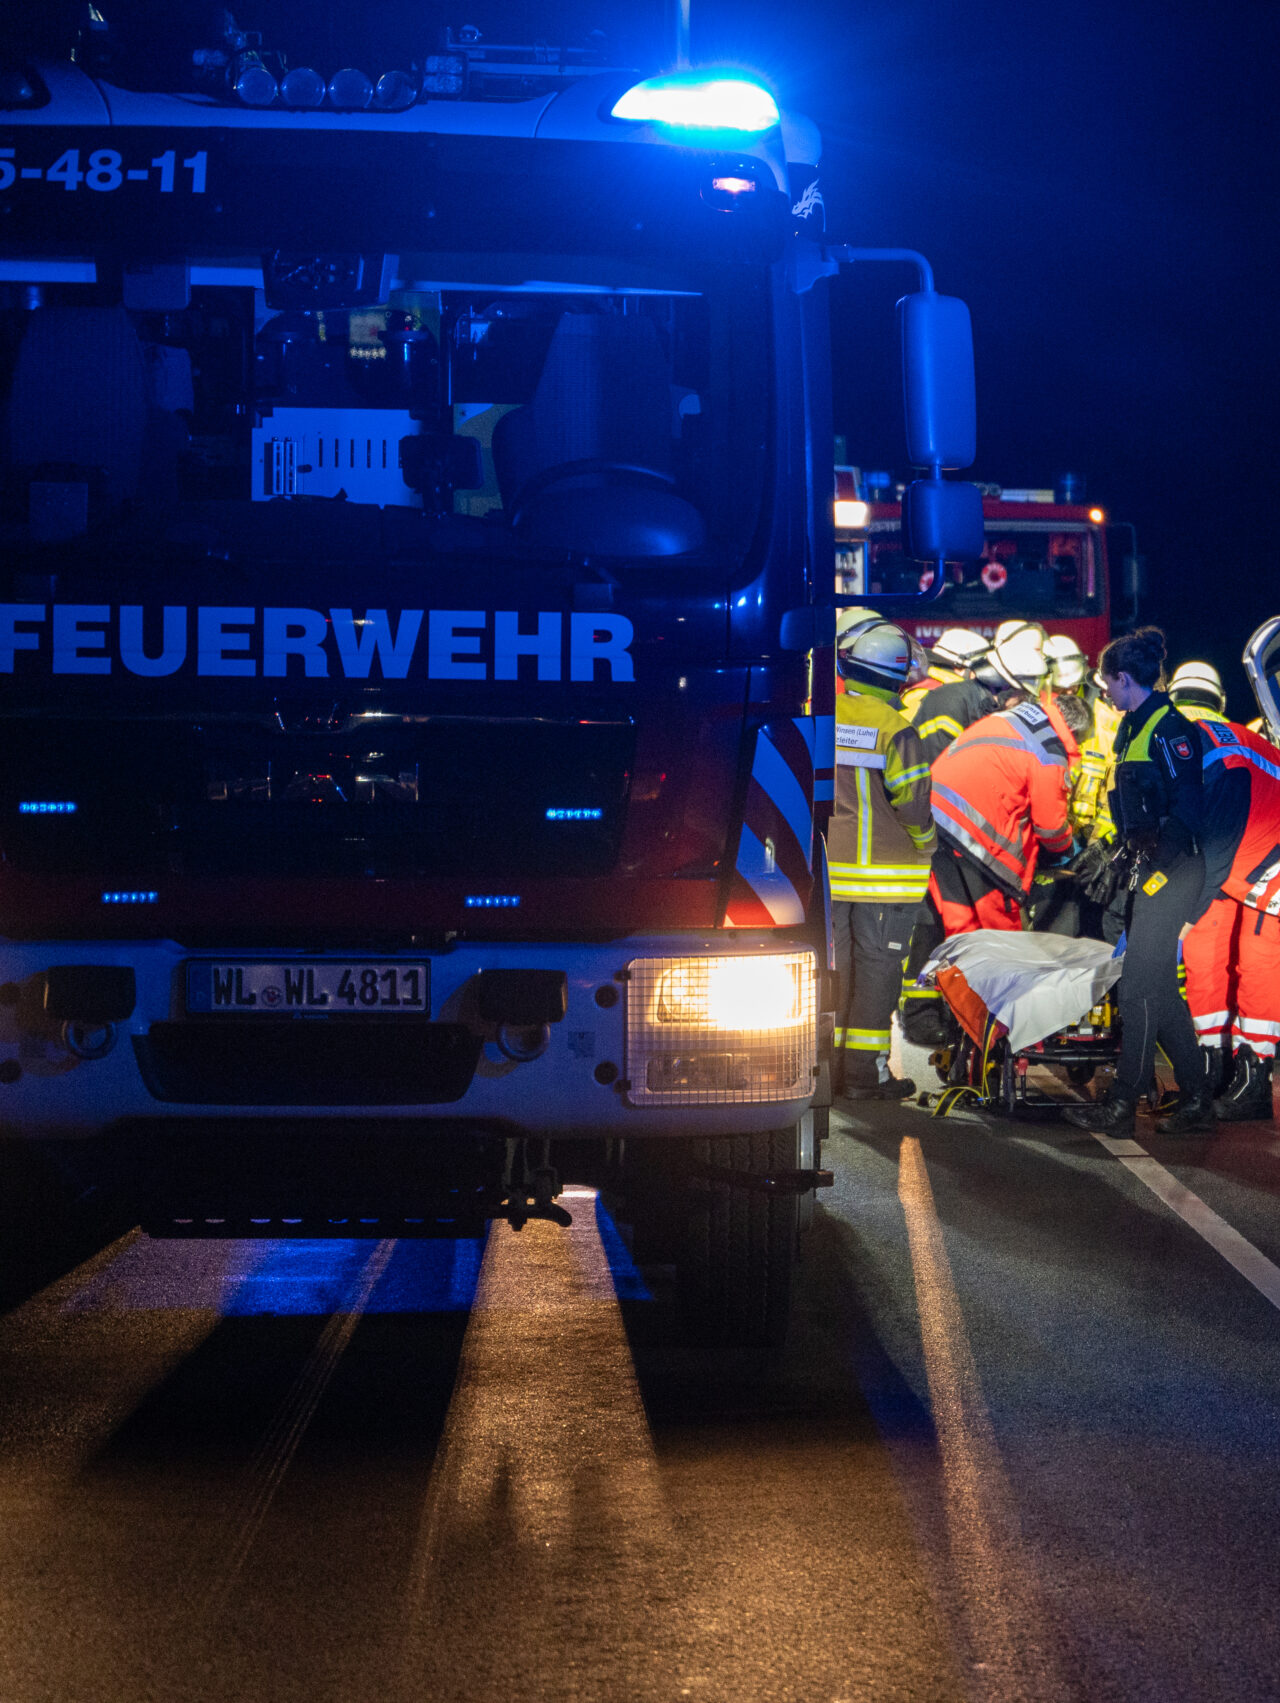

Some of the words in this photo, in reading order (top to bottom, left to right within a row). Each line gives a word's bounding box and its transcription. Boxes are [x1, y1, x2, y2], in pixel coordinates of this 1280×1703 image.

[0, 603, 637, 682] FEUERWEHR
[213, 968, 256, 1005] WL
[285, 968, 328, 1005] WL
[337, 969, 422, 1006] 4811
